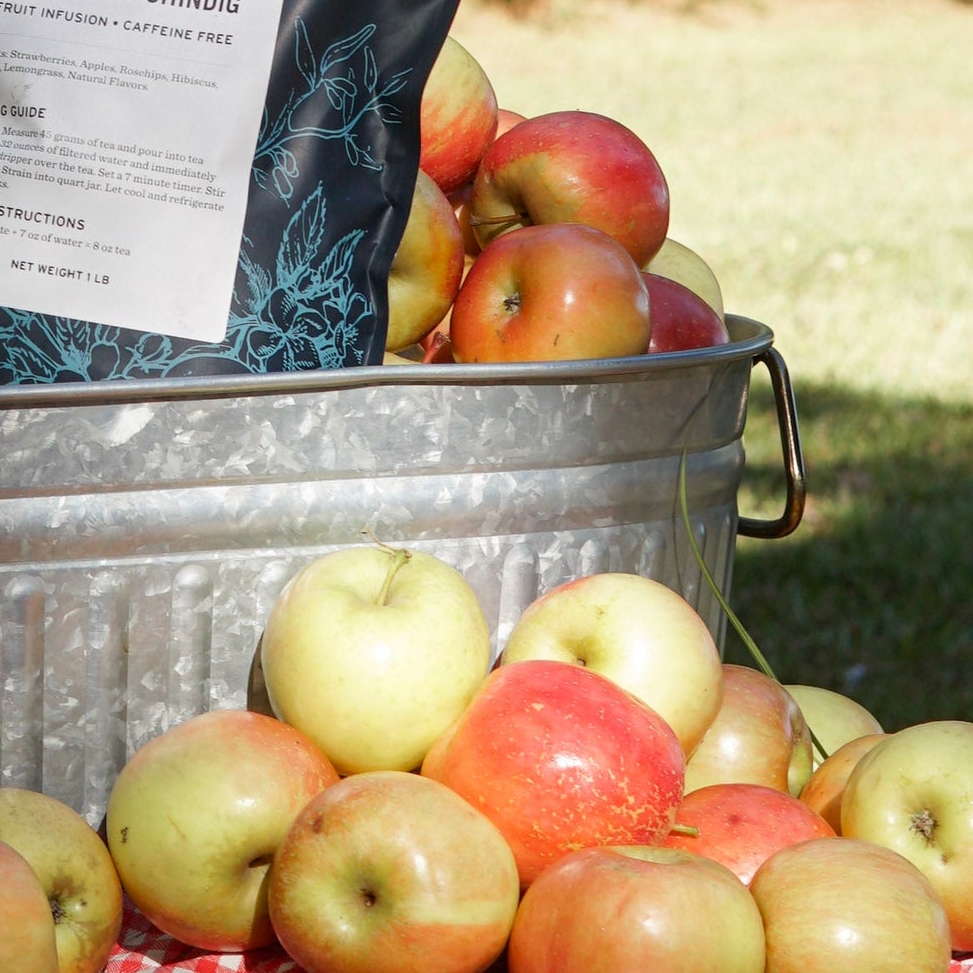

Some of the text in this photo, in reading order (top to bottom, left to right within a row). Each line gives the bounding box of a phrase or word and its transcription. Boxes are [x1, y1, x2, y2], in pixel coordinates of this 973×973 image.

[41, 7, 108, 27] INFUSION
[123, 20, 193, 40] CAFFEINE
[197, 31, 233, 45] FREE
[3, 63, 66, 79] Lemongrass,
[67, 71, 107, 85] Natural
[119, 65, 168, 81] Rosehips,
[171, 73, 219, 89] Hibiscus,
[10, 106, 46, 118] GUIDE
[0, 138, 13, 148] 32
[13, 141, 45, 153] ounces
[46, 144, 59, 154] of
[59, 145, 96, 161] filtered
[99, 155, 128, 166] water
[130, 160, 149, 170] and
[151, 163, 217, 183] immediately
[2, 127, 39, 138] Measure
[53, 133, 85, 145] grams
[87, 138, 99, 147] of
[100, 140, 115, 150] tea
[117, 144, 136, 154] and
[137, 147, 163, 158] pour
[165, 150, 186, 162] into
[188, 155, 204, 165] tea
[1, 165, 32, 179] Strain
[34, 170, 55, 183] into
[56, 176, 85, 188] quart
[105, 183, 122, 195] Let
[124, 187, 146, 199] cool
[147, 191, 167, 202] and
[169, 194, 225, 212] refrigerate
[34, 157, 57, 168] over
[58, 160, 76, 172] the
[98, 167, 115, 178] Set
[116, 172, 123, 180] a
[125, 173, 132, 181] 7
[133, 175, 174, 189] minute
[205, 186, 225, 198] Stir
[20, 229, 27, 237] 7
[28, 232, 39, 241] oz
[41, 234, 53, 243] of
[53, 237, 83, 248] water
[92, 241, 100, 250] 8
[101, 245, 113, 253] oz
[115, 246, 131, 256] tea
[11, 259, 34, 271] NET
[38, 264, 83, 280] WEIGHT
[94, 274, 110, 284] LB
